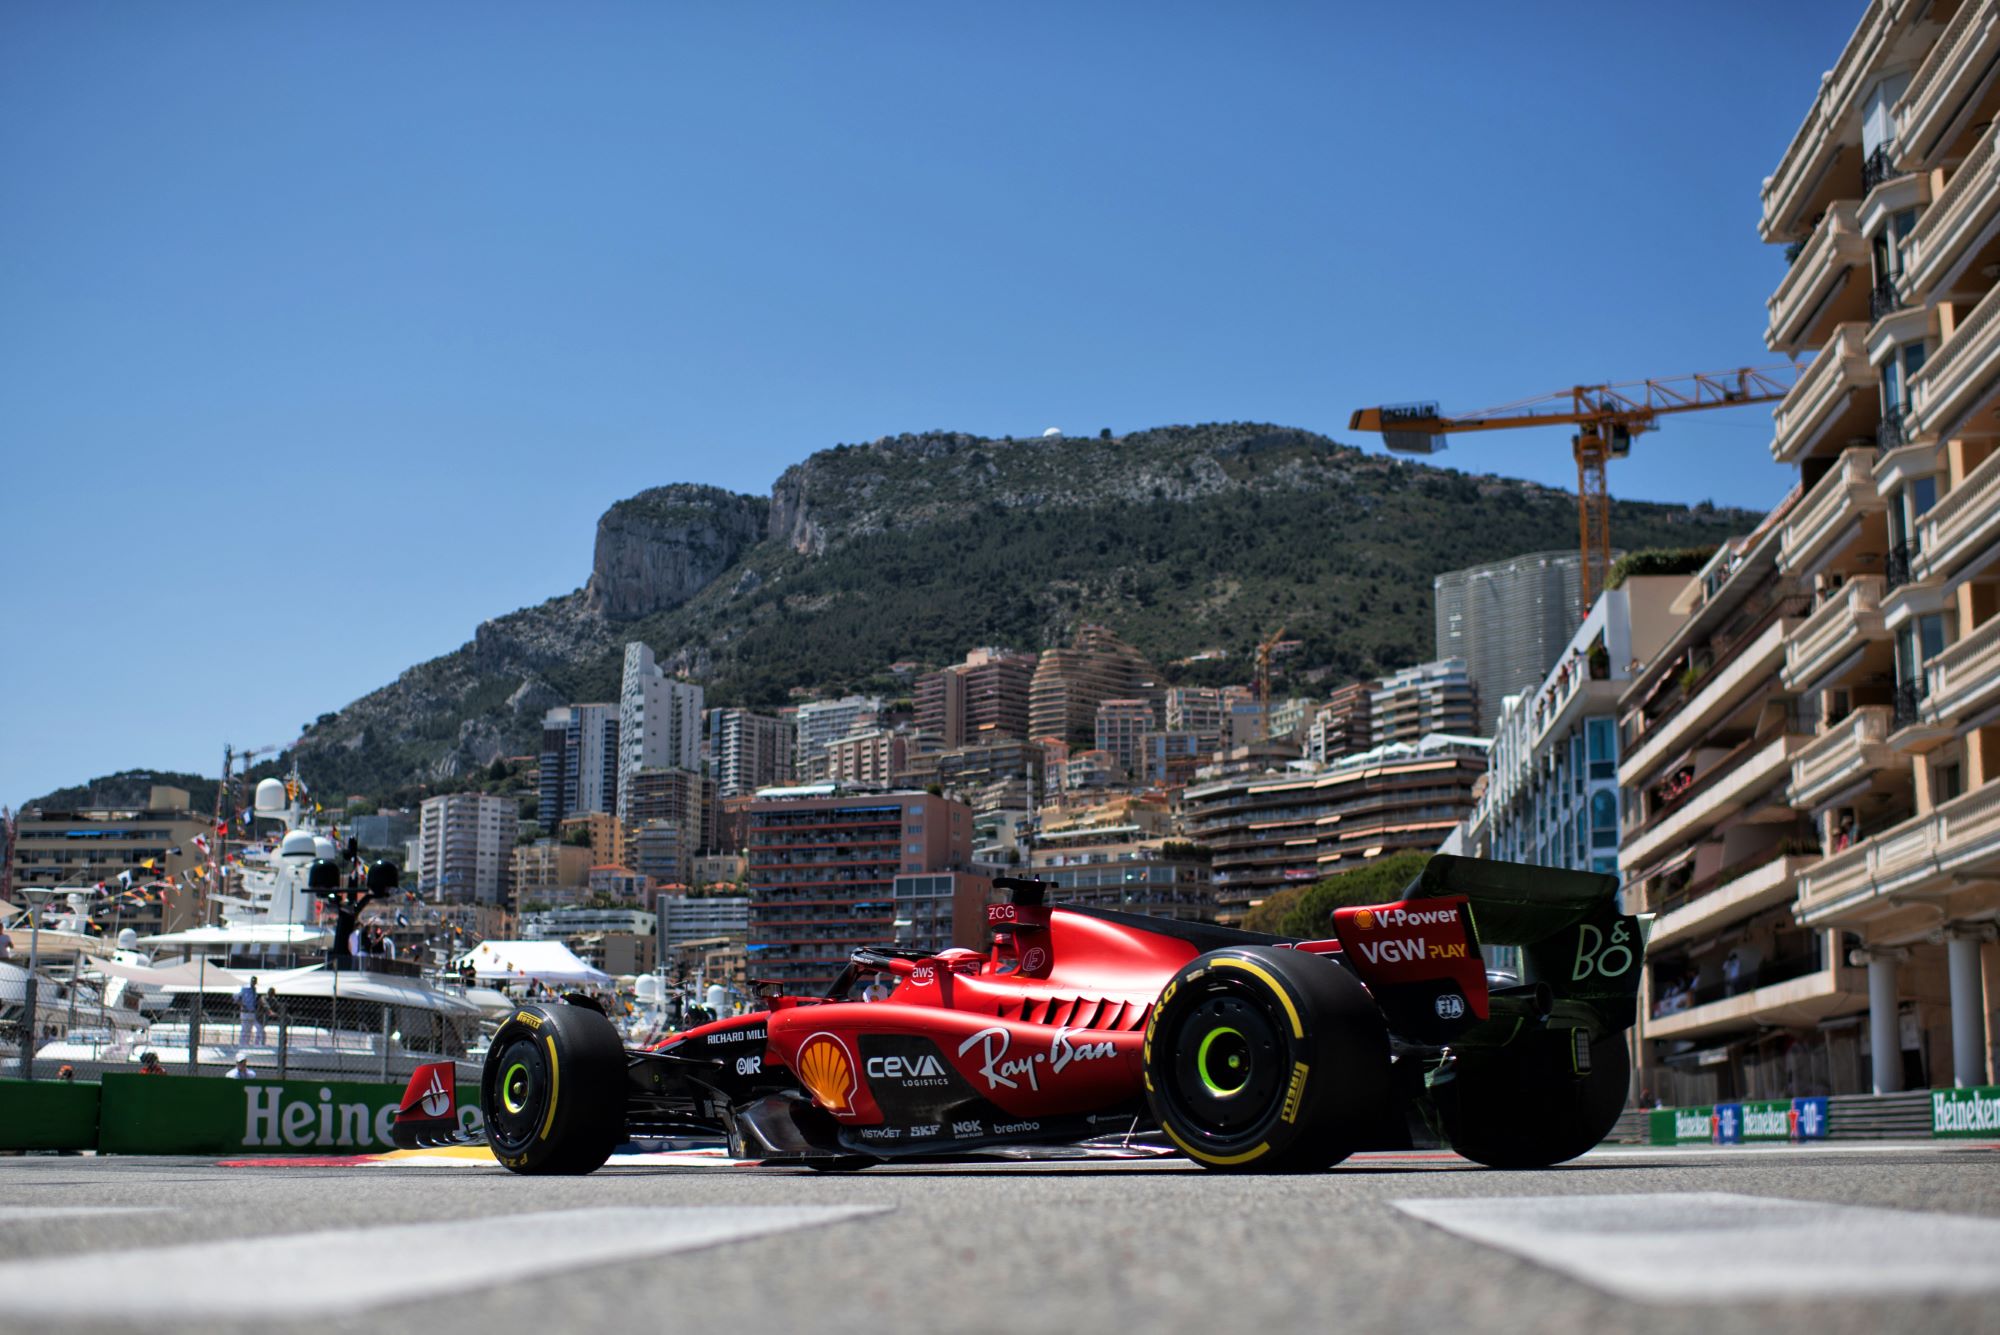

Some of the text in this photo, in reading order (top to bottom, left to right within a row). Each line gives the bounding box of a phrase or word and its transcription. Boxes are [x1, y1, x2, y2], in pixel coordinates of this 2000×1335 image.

[1374, 909, 1457, 928] V-Power
[1358, 938, 1425, 965] VGW
[1428, 943, 1466, 959] PLAY
[912, 966, 934, 978] aws
[707, 1028, 768, 1045] RICHARD MILL
[902, 1078, 949, 1087] LOGISTICS
[1281, 1061, 1309, 1124] PIRELLI
[952, 1119, 983, 1134] NGK
[993, 1121, 1040, 1134] brembo
[1742, 1104, 1788, 1136] Heineken
[910, 1125, 940, 1137] SKF
